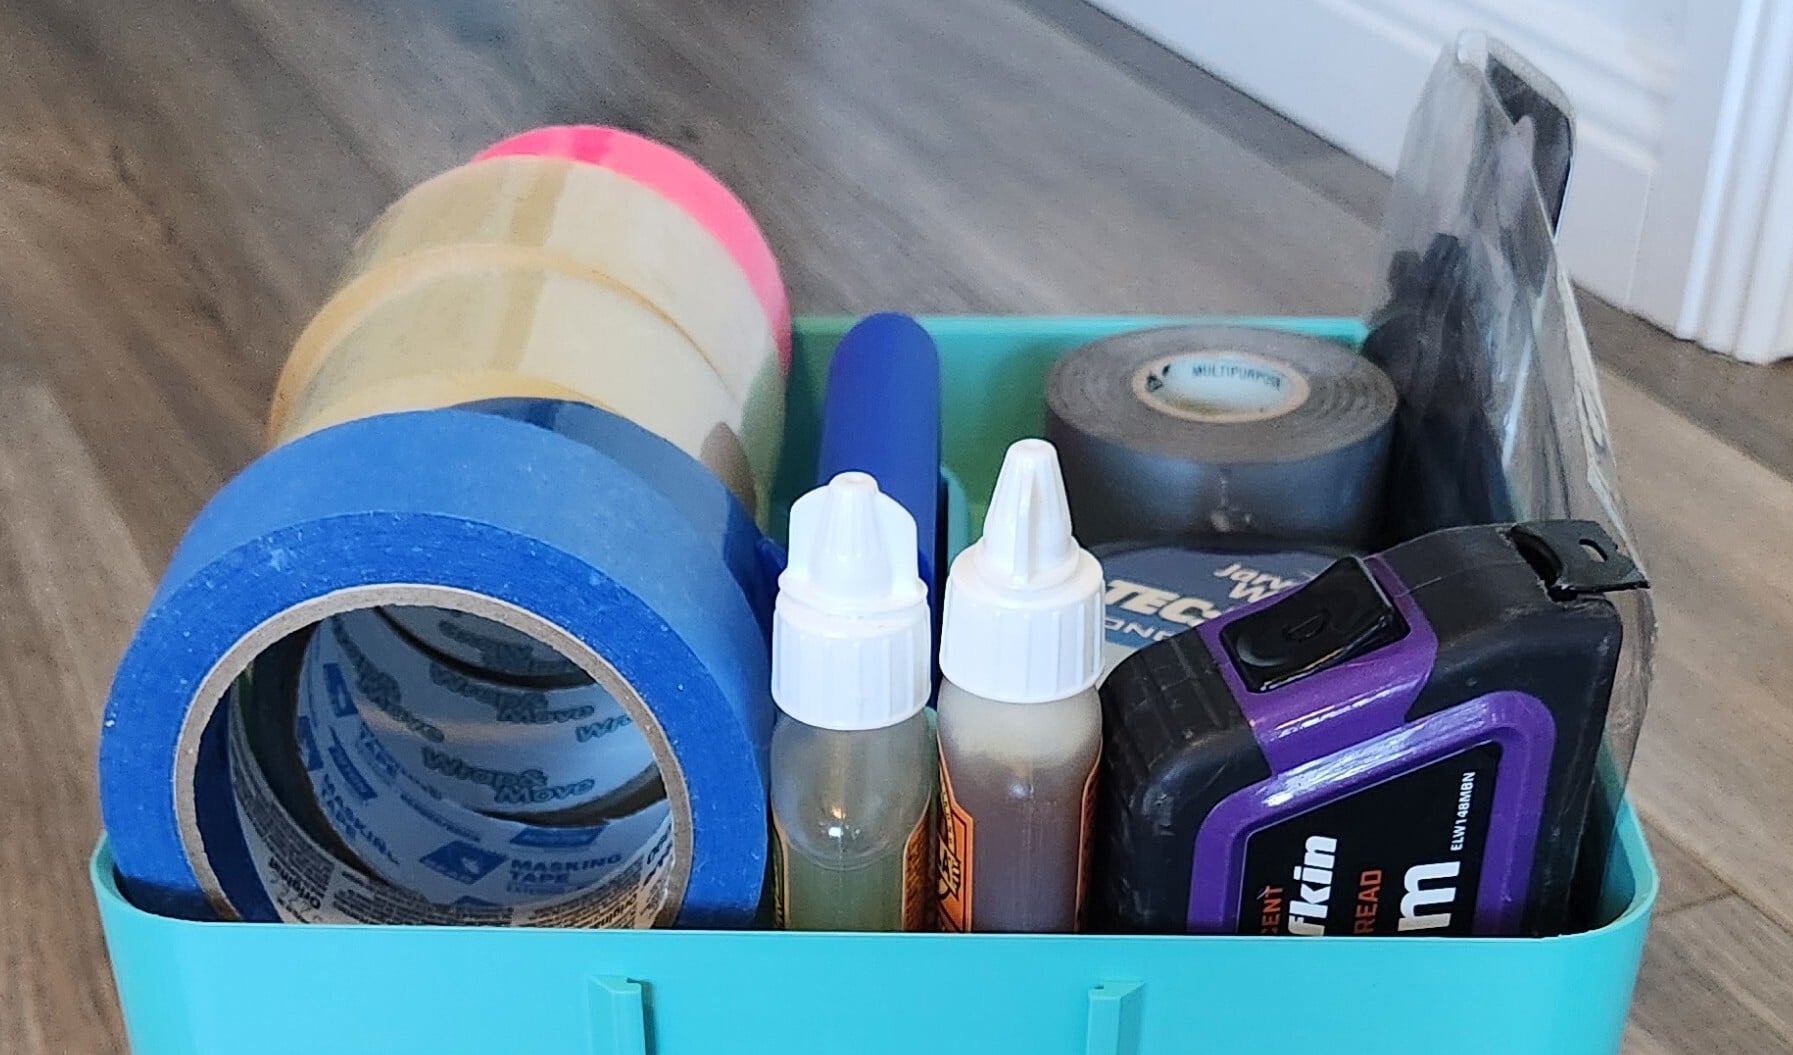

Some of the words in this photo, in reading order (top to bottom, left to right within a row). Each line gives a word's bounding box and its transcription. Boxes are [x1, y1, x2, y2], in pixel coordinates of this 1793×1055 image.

[1105, 579, 1223, 627] TEC
[1450, 771, 1476, 851] ELW148MBN
[510, 871, 570, 883] TAPE
[511, 854, 622, 871] MASKING
[1288, 835, 1337, 936] fkin
[1353, 869, 1382, 934] READ
